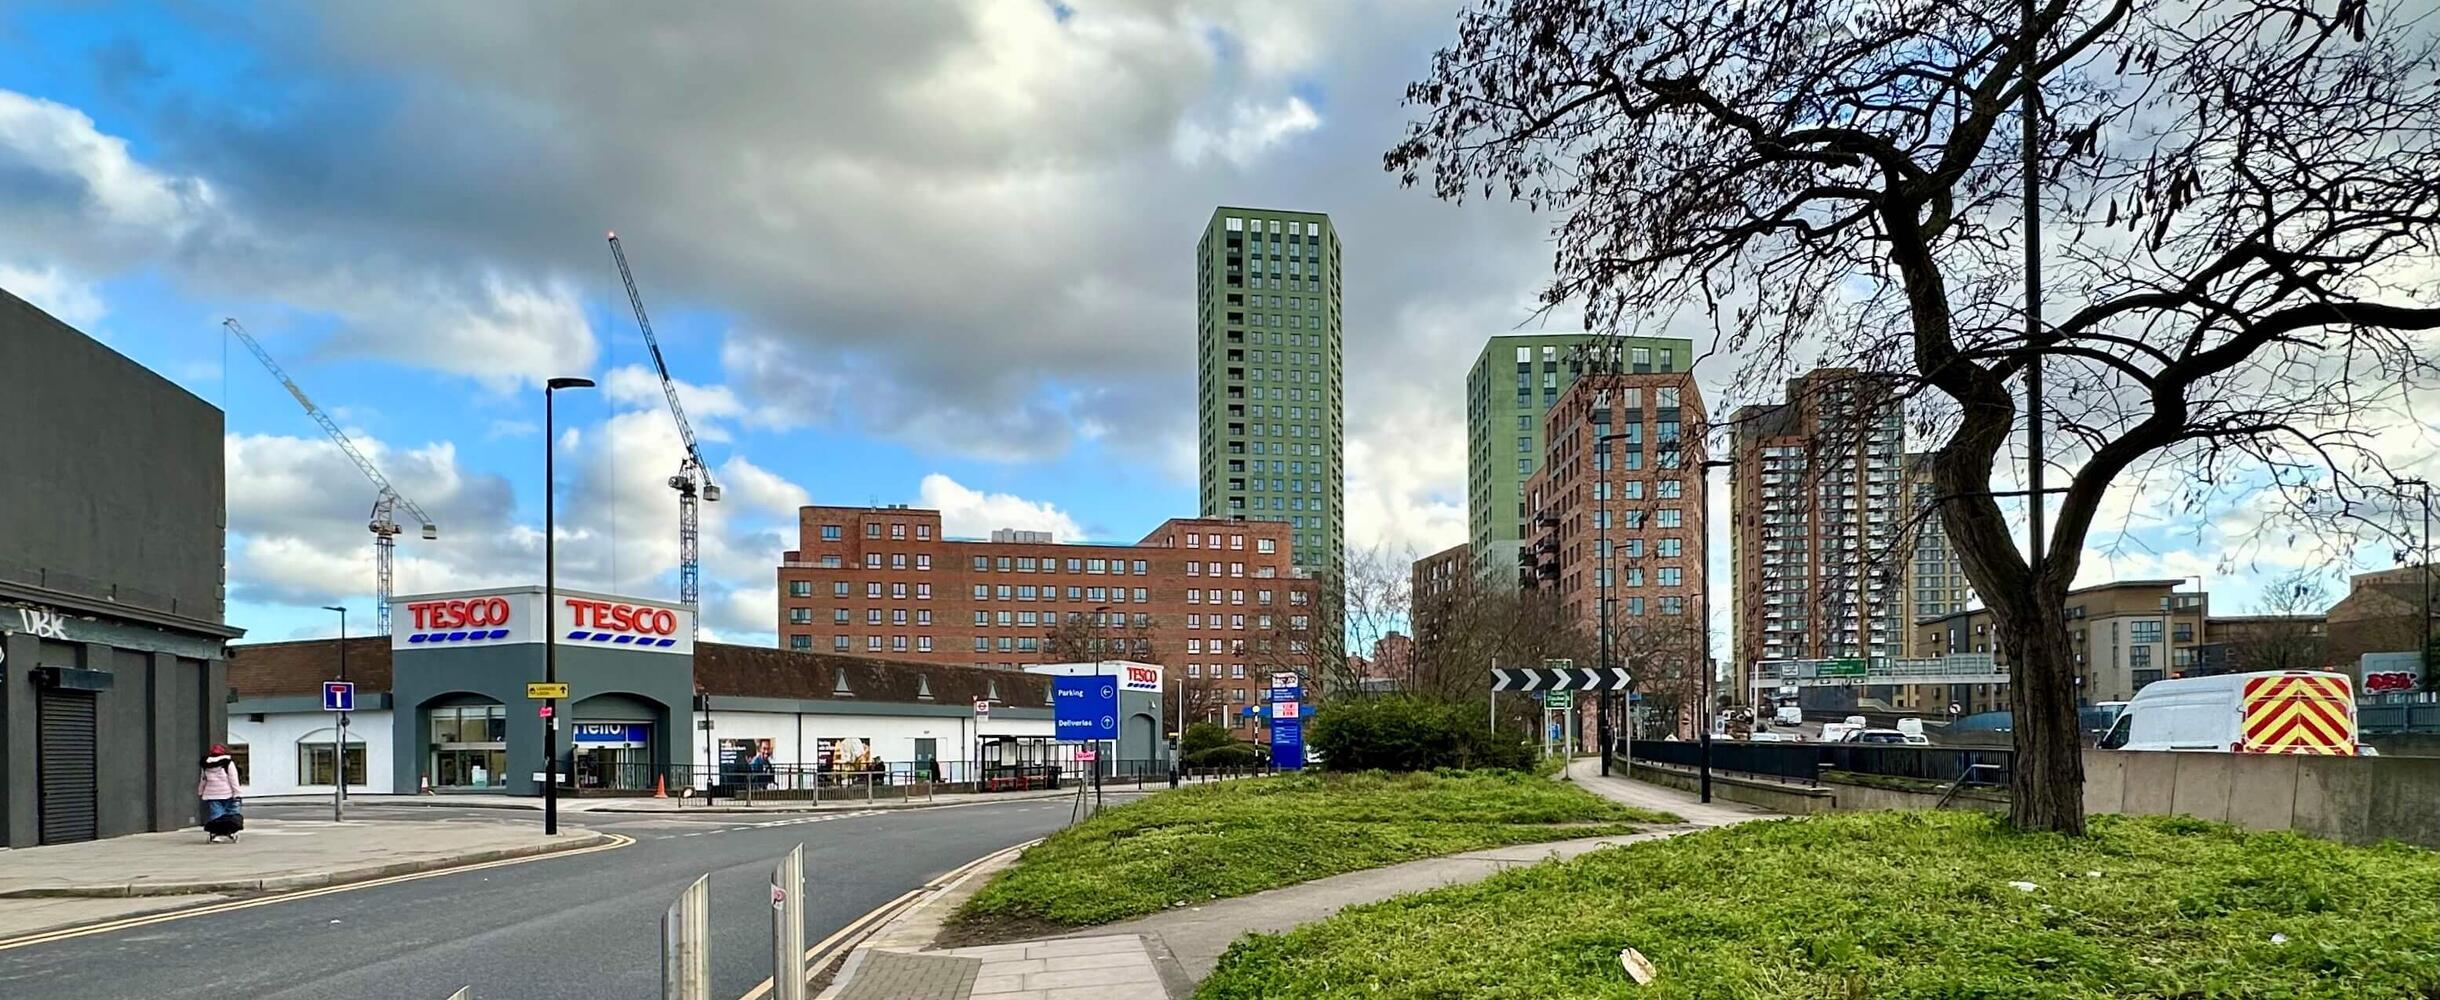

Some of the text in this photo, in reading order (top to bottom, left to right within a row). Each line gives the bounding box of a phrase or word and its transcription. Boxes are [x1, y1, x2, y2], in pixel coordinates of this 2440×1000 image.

[408, 597, 510, 630] TESCO
[566, 599, 677, 635] TESCO
[1127, 667, 1157, 683] TESCO
[1058, 689, 1084, 698] Parking
[1058, 719, 1092, 727] Deliveries
